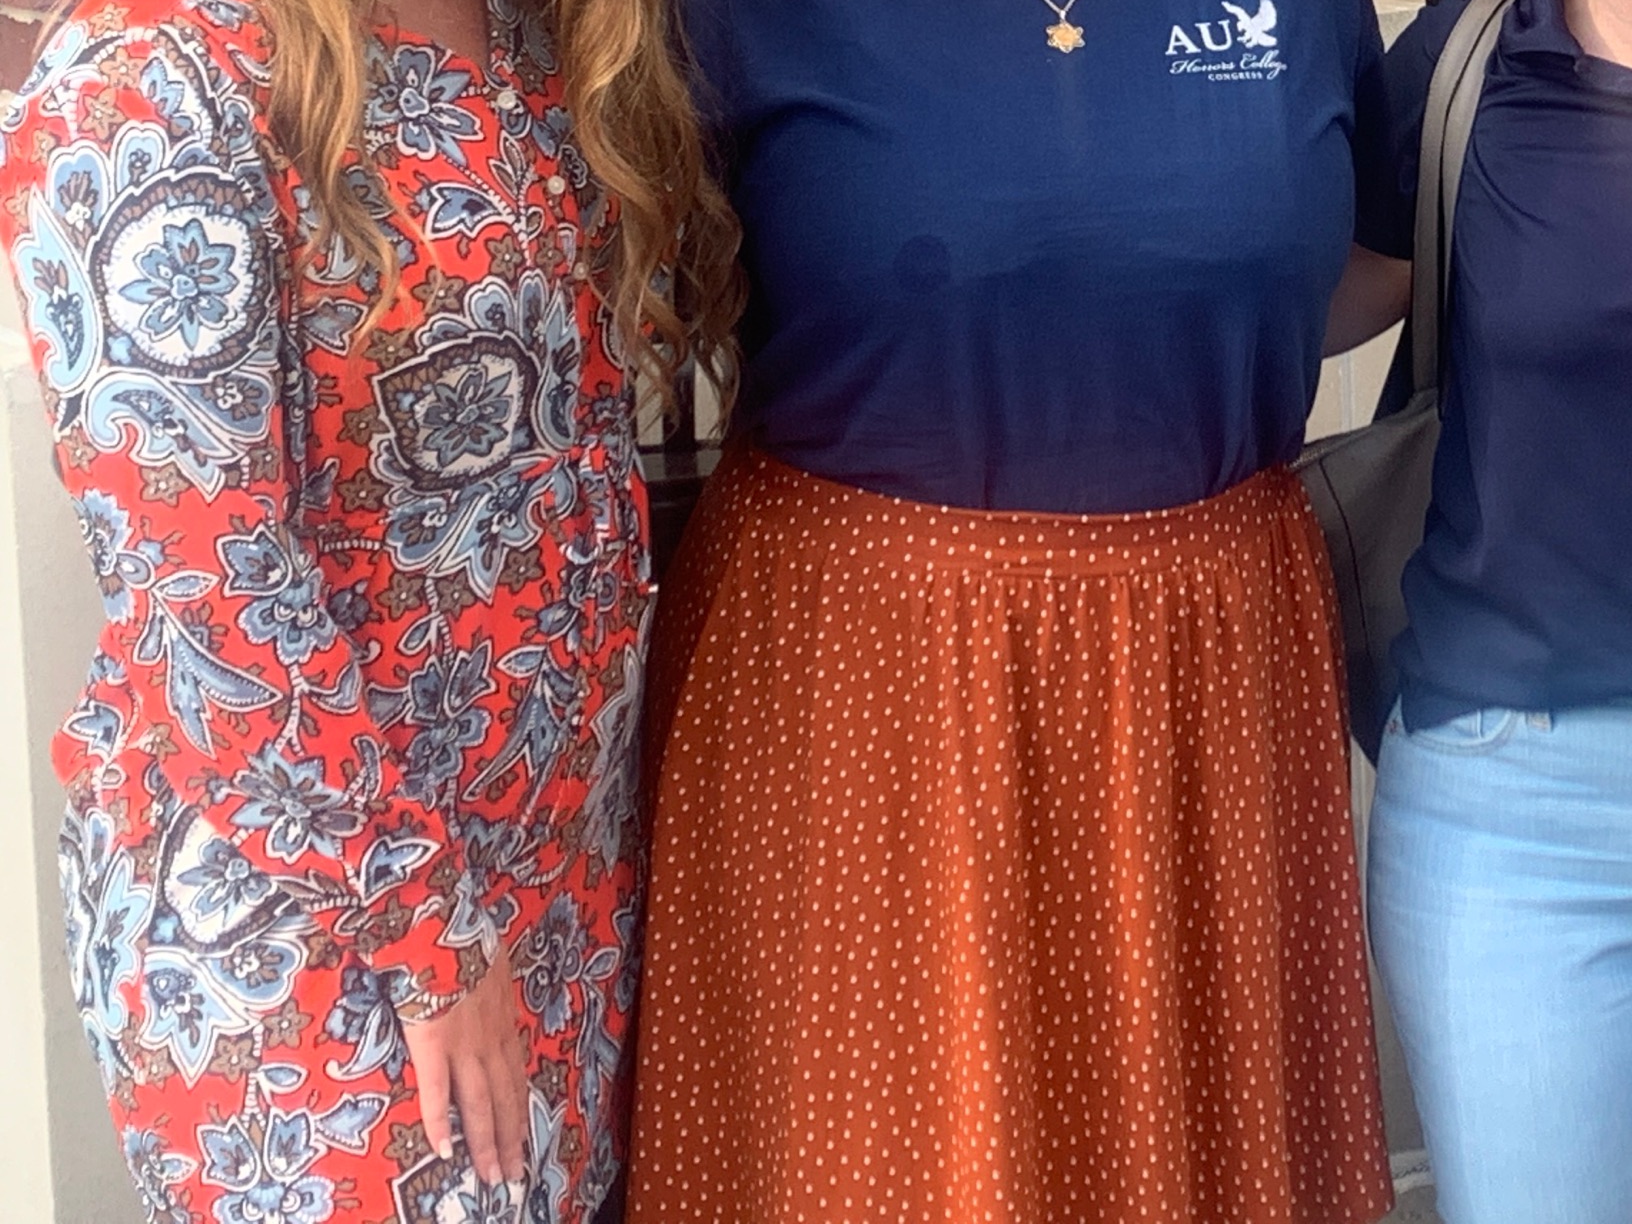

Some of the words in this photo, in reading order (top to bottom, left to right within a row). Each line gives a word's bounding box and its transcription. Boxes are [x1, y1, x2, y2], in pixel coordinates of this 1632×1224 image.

[1165, 20, 1233, 55] AU
[1169, 58, 1236, 74] Honors
[1239, 49, 1288, 80] College
[1207, 71, 1263, 81] CONGRESS
